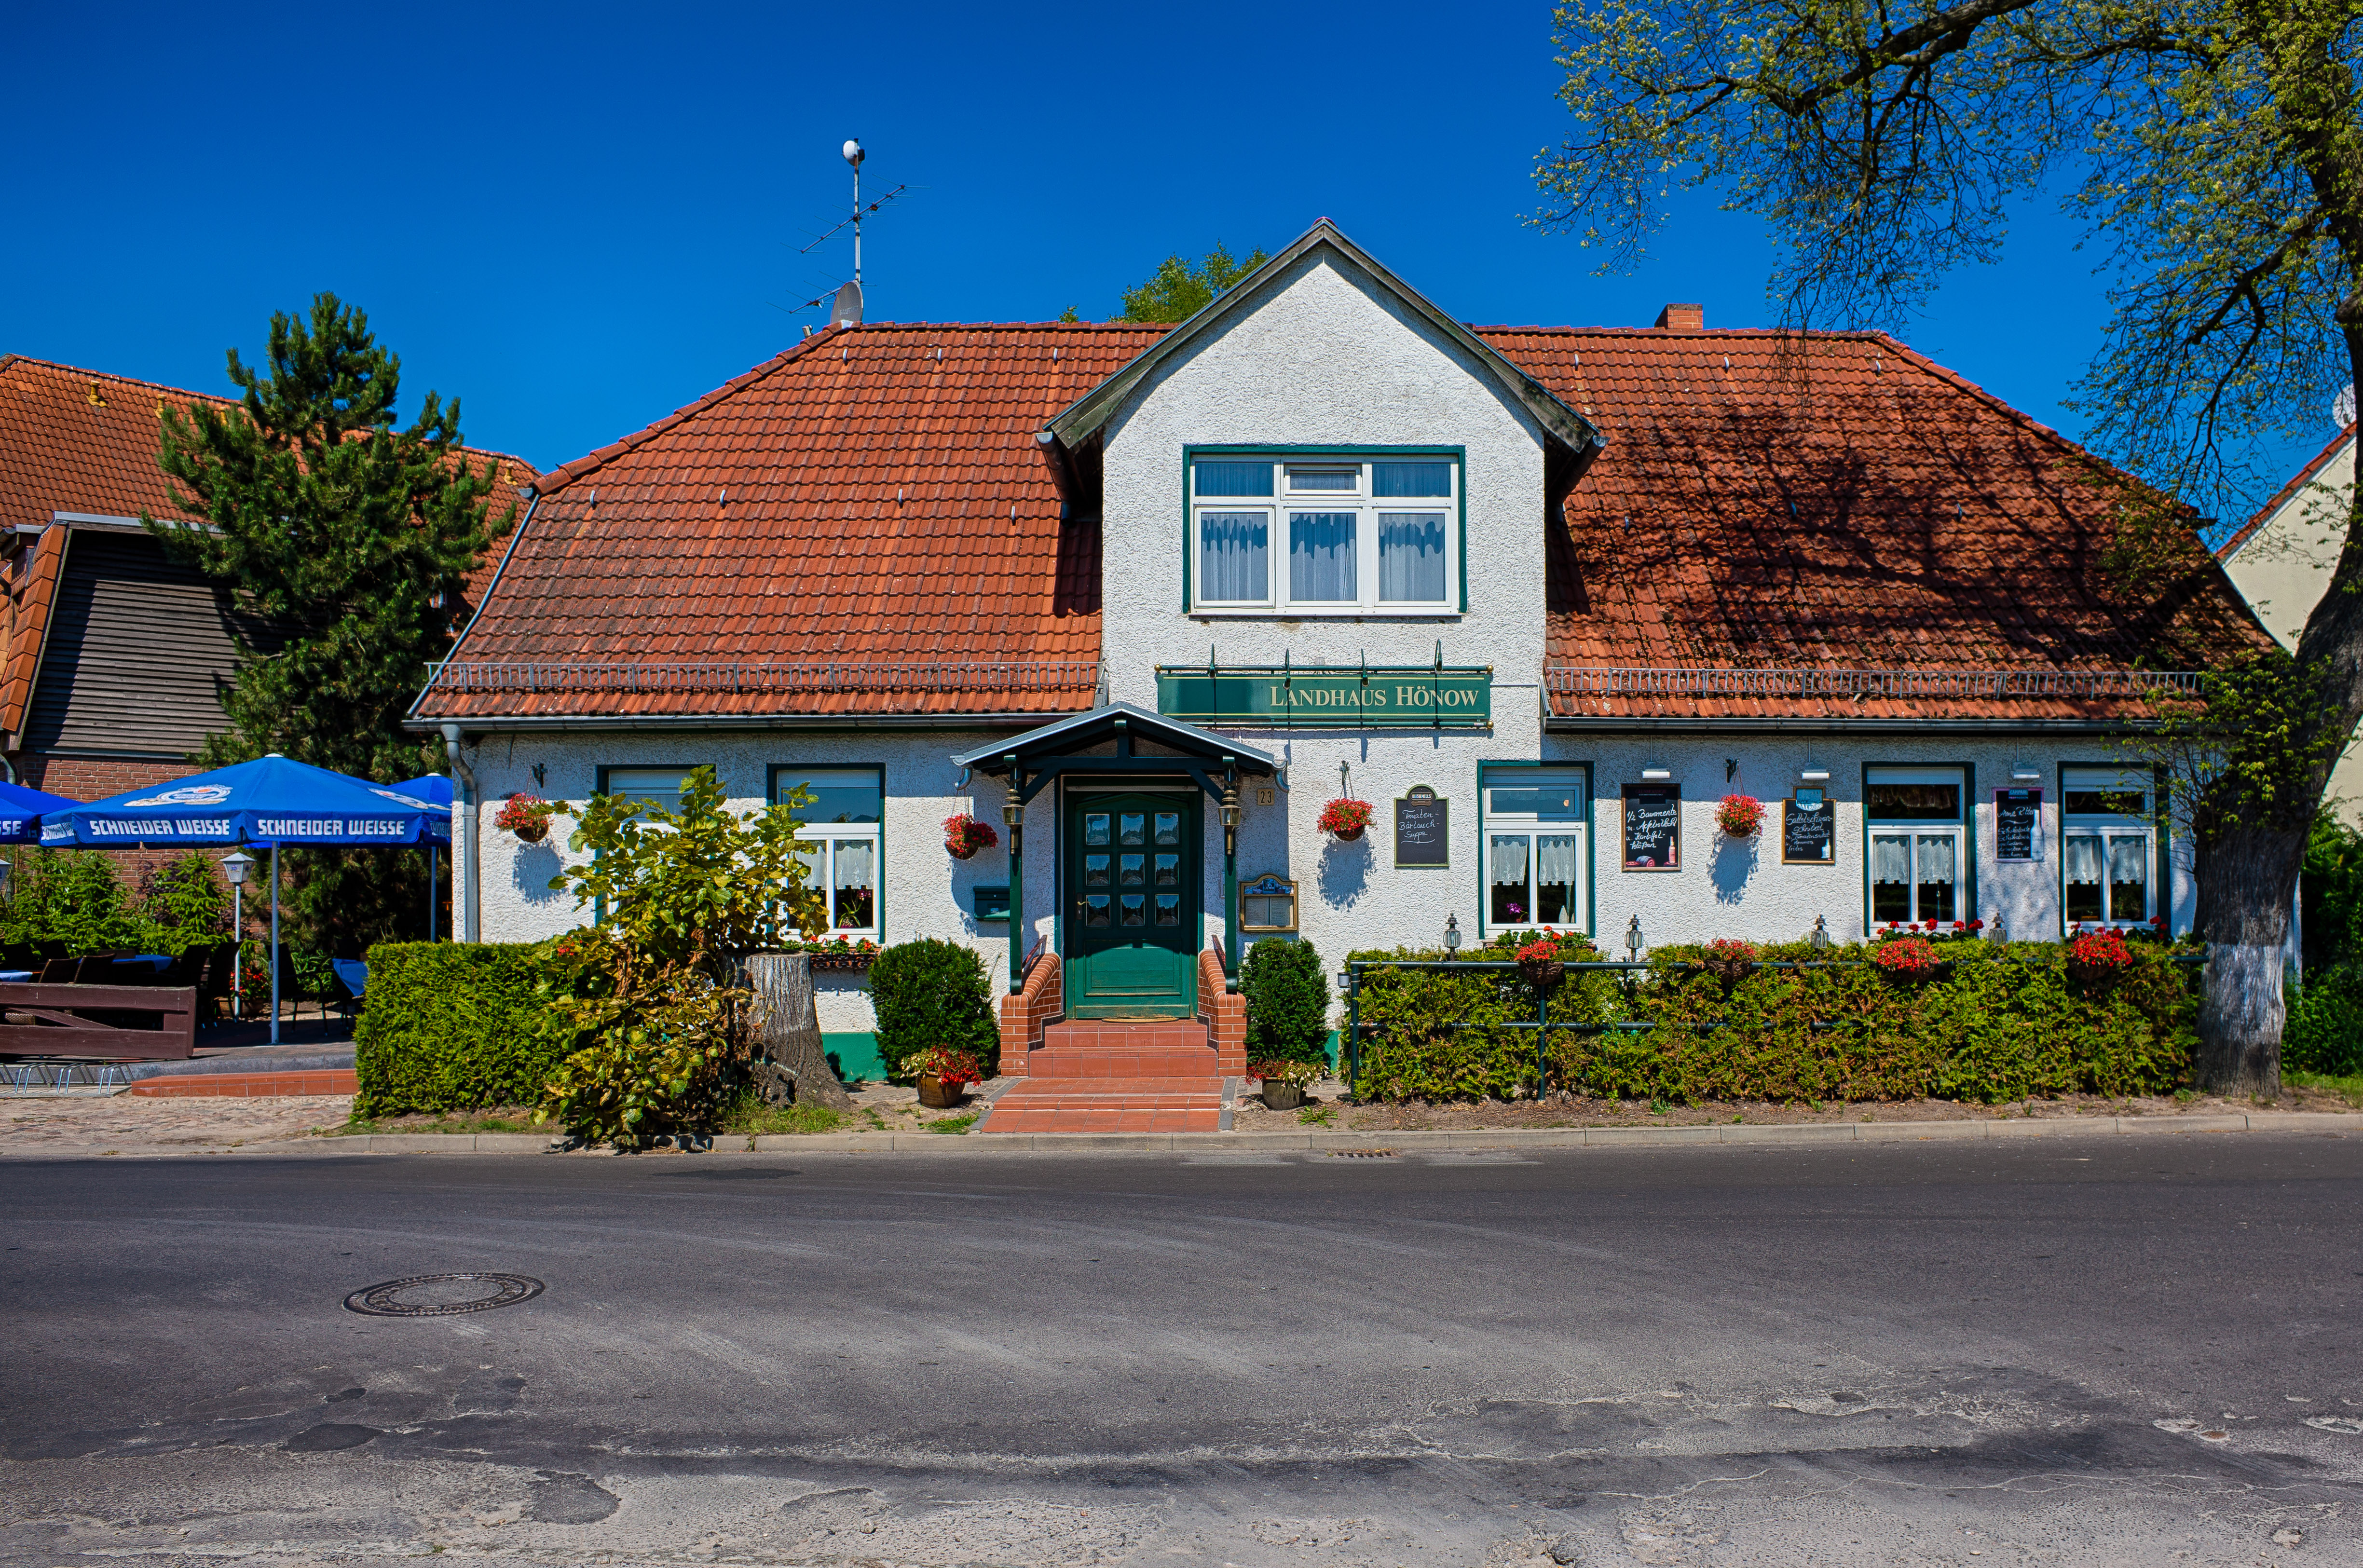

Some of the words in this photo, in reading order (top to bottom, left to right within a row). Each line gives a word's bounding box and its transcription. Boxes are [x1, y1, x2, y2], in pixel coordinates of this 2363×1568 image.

[1270, 686, 1386, 707] LANDHAUS
[1395, 685, 1479, 707] HÖNOW
[1260, 791, 1272, 803] 23
[1626, 811, 1636, 823] 1/2
[90, 820, 174, 835] SCHNEIDER
[176, 819, 230, 835] WEISSE
[258, 819, 343, 835] SCHNEIDER
[348, 820, 406, 835] WEISSE
[1634, 830, 1666, 843] Kartoffel-
